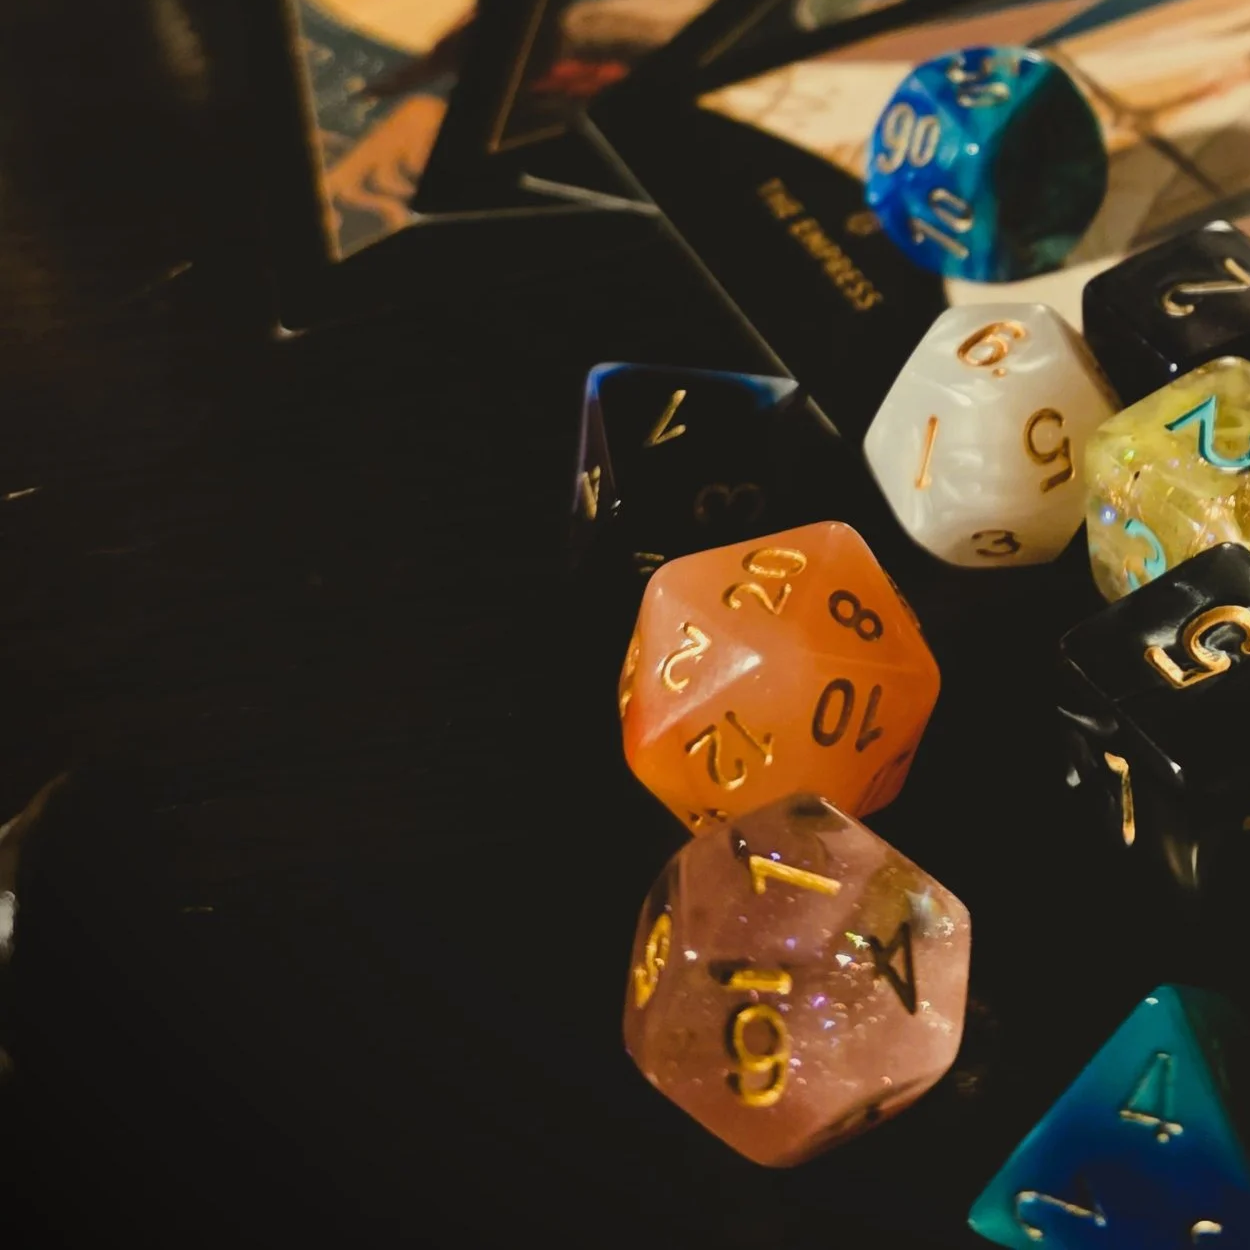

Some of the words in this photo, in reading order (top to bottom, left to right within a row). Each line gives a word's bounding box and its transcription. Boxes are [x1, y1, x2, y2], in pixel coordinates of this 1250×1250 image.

[877, 102, 942, 175] 90
[1023, 407, 1076, 493] 5
[721, 546, 808, 616] 20
[827, 589, 884, 642] 8
[655, 621, 713, 694] 2
[685, 710, 776, 791] 12
[811, 677, 885, 754] 10
[1119, 1052, 1184, 1144] 4
